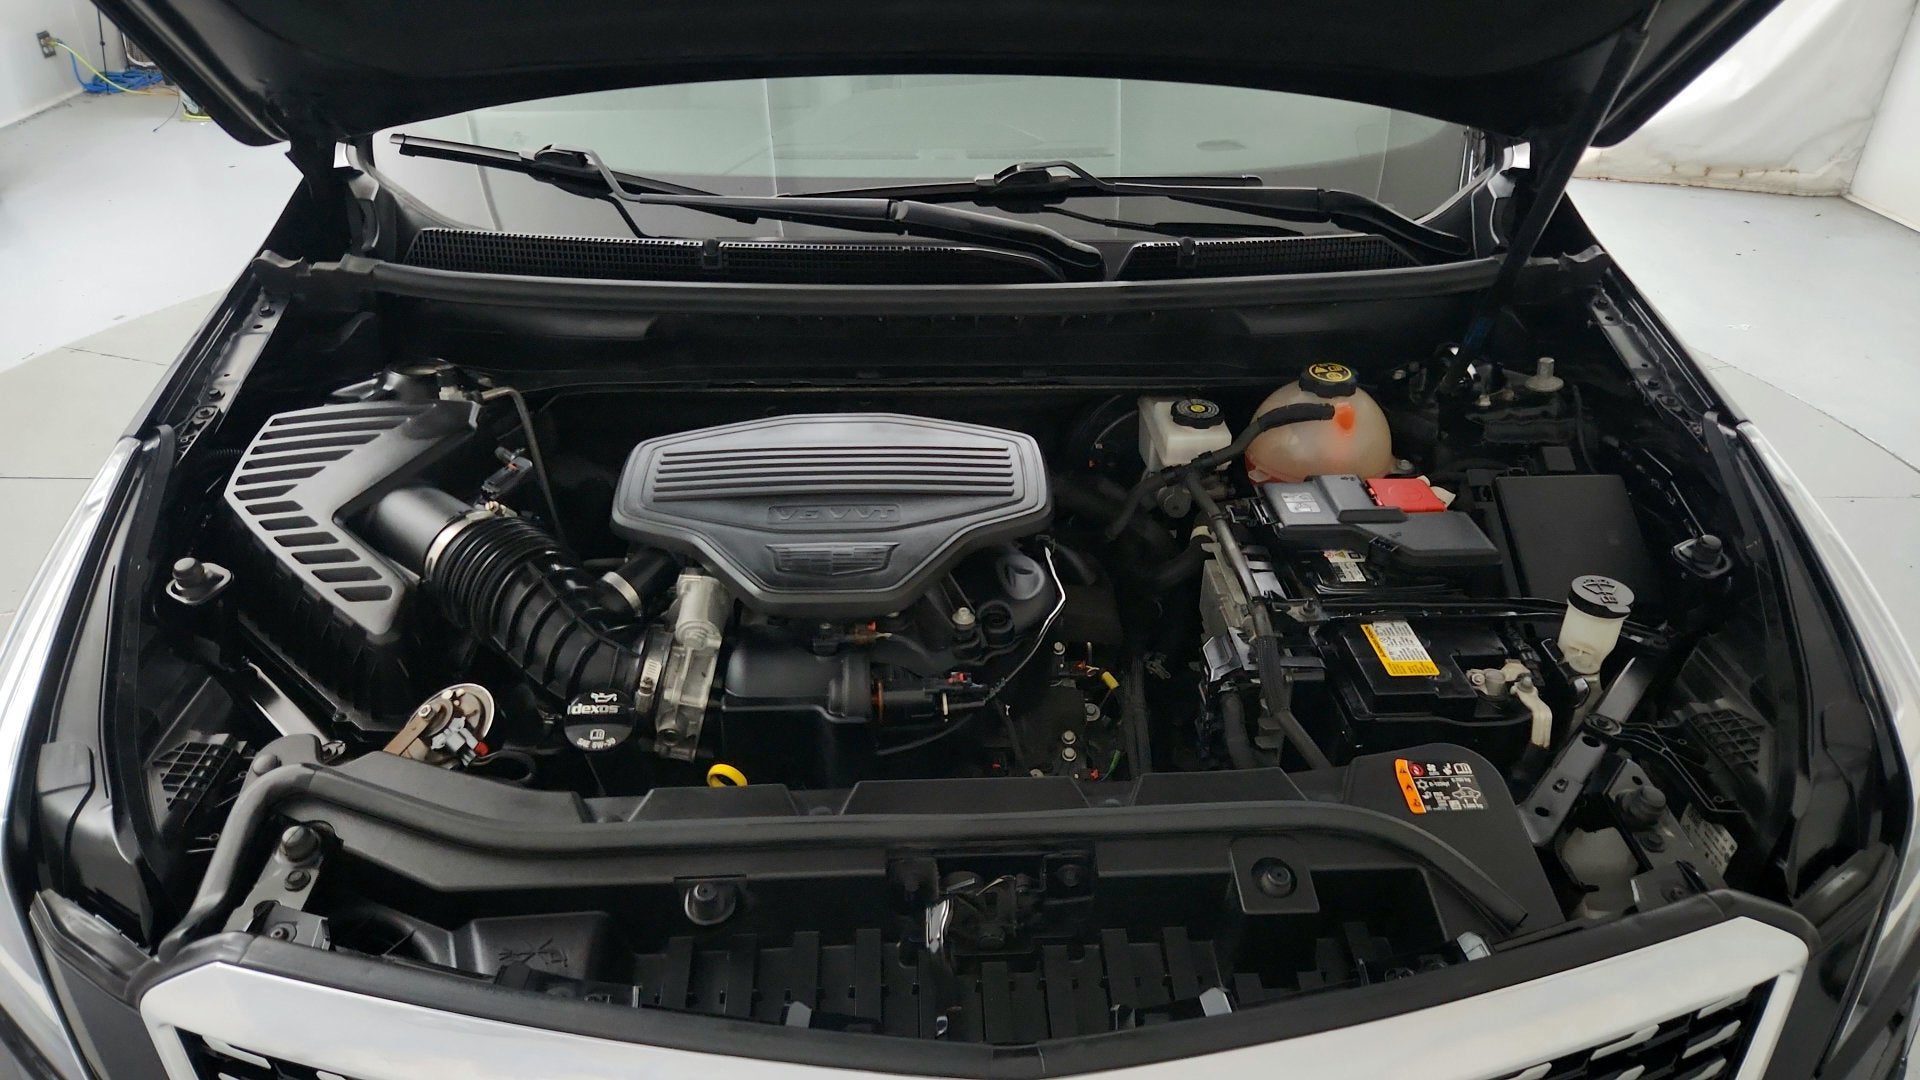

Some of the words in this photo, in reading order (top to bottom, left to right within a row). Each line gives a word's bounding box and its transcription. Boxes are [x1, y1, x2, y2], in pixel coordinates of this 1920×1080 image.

[776, 507, 820, 520] V6
[829, 506, 895, 519] VVT
[571, 703, 619, 715] dexos
